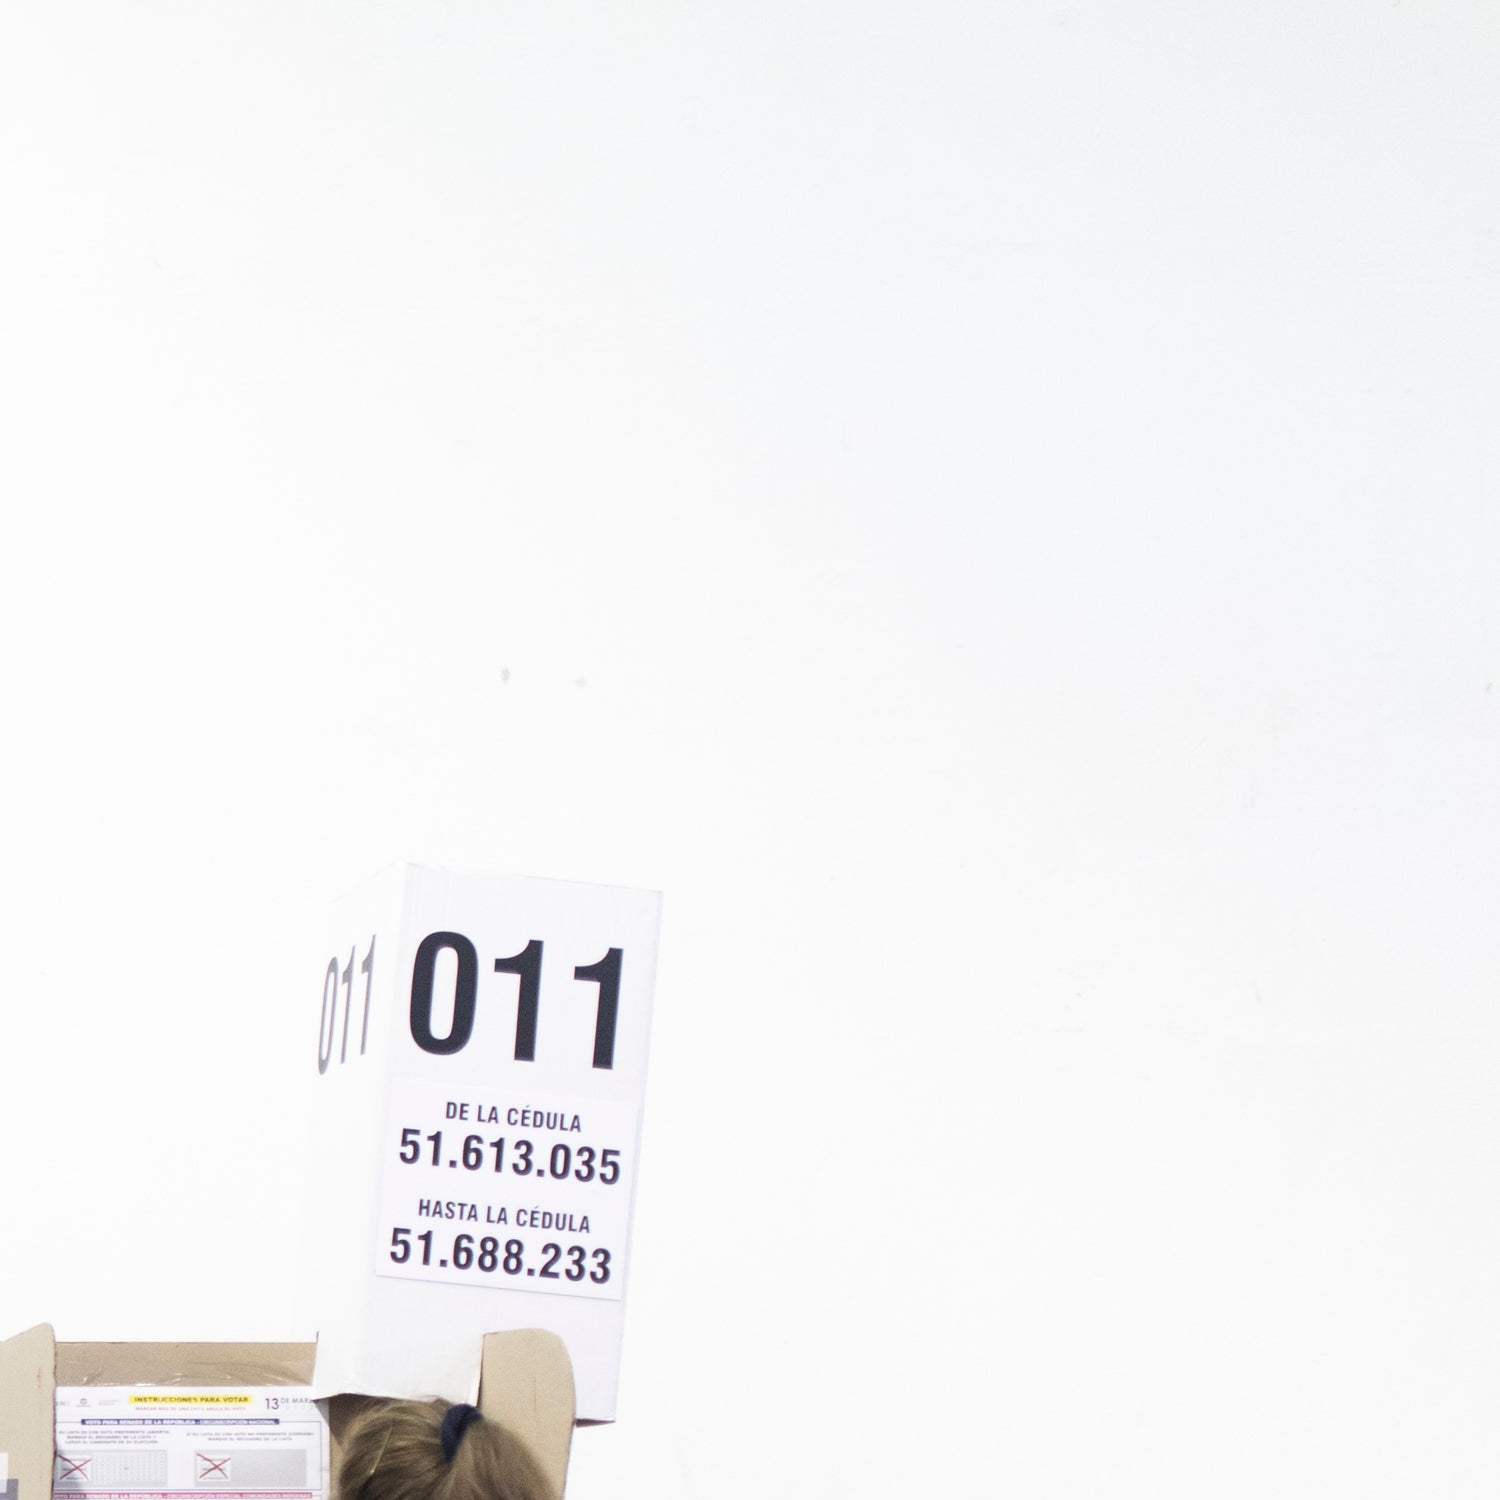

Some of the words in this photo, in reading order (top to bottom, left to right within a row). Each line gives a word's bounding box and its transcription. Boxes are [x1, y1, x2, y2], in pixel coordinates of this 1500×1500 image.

[317, 933, 377, 1076] 011
[409, 931, 624, 1071] 011
[445, 1101, 470, 1121] DE
[477, 1104, 499, 1124] LA
[507, 1104, 581, 1133] CÉDULA
[399, 1127, 621, 1185] 51.613.035
[418, 1198, 478, 1222] HASTA
[486, 1205, 508, 1225] LA
[515, 1205, 590, 1234] CÉDULA
[390, 1227, 612, 1284] 51.688.233
[265, 1398, 280, 1410] 13
